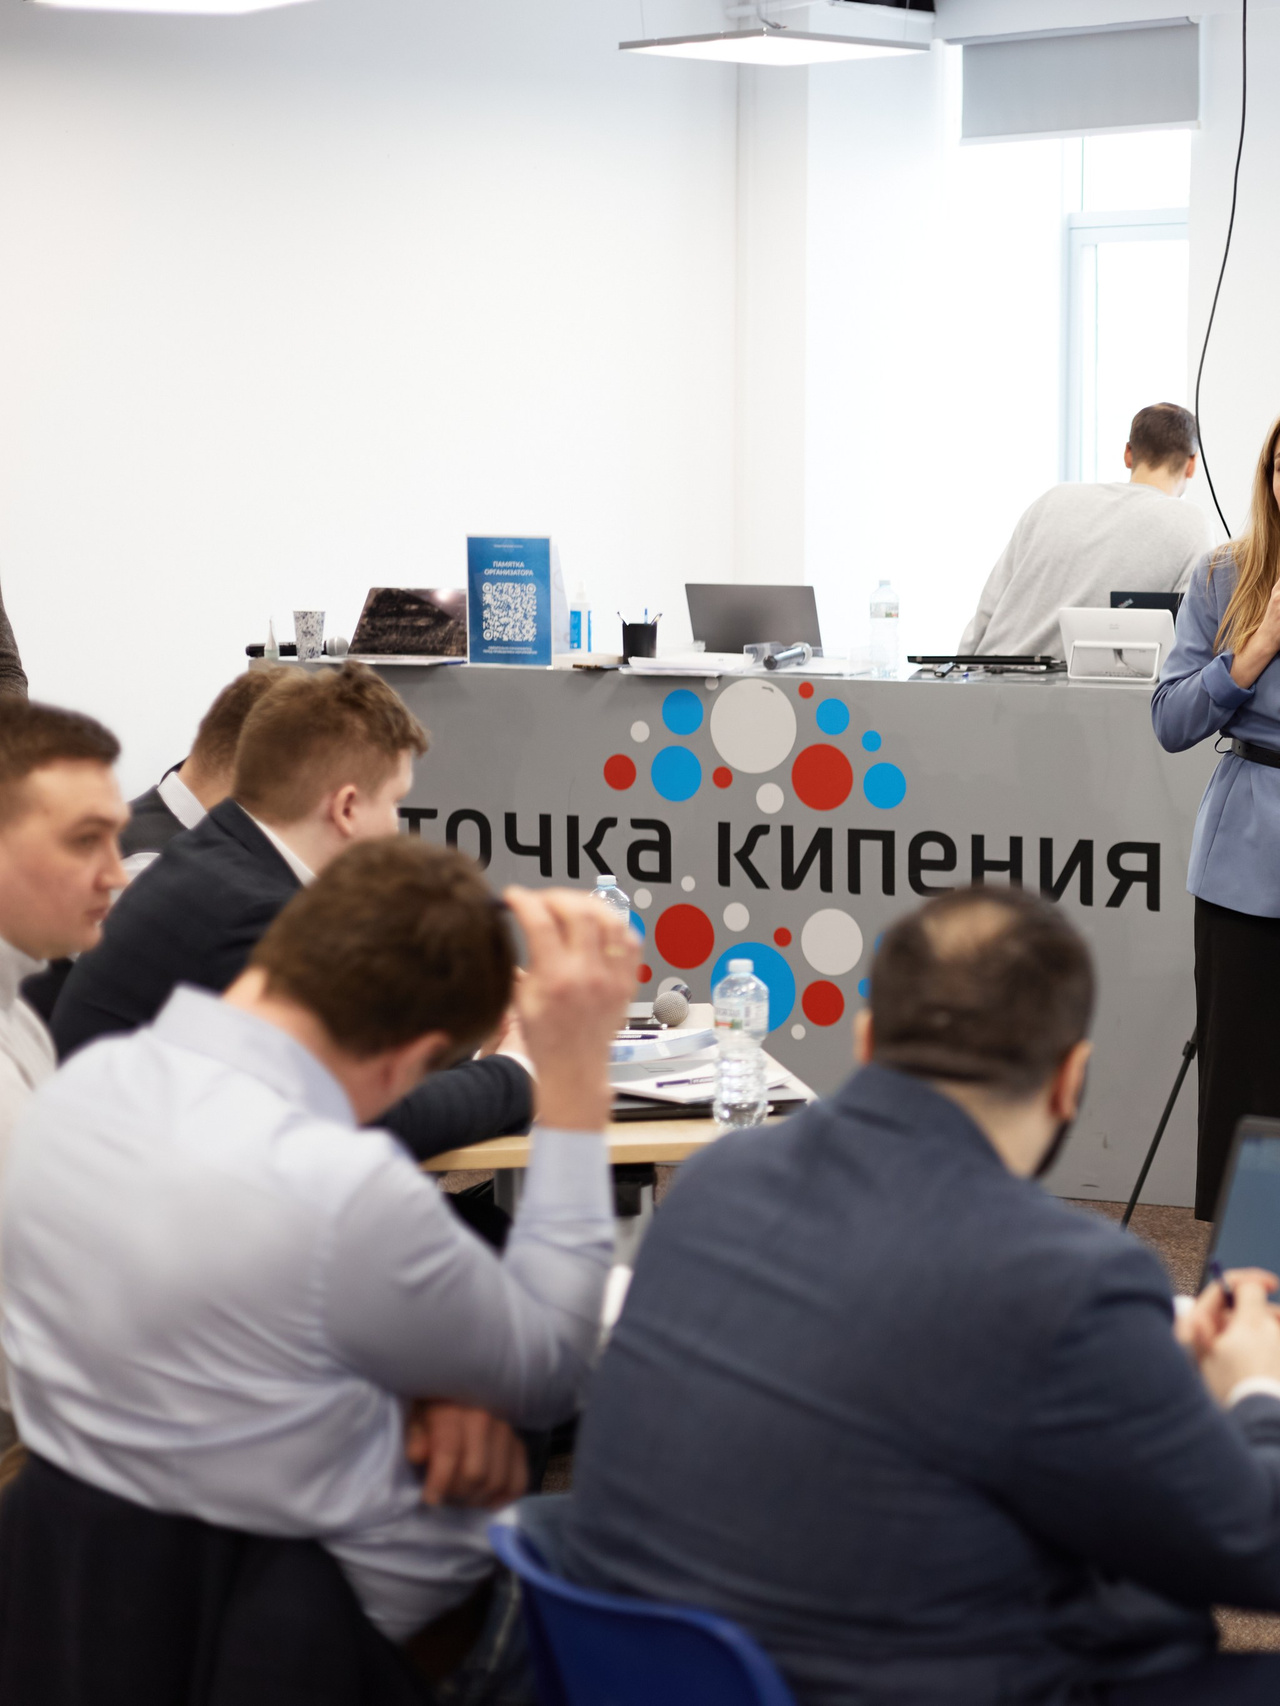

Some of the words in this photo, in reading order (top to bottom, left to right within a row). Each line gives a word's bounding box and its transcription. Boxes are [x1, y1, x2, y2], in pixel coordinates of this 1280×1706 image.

[484, 568, 534, 577] ОРГАНИЗАТОРА
[397, 807, 672, 884] точка
[718, 821, 1161, 912] кипения
